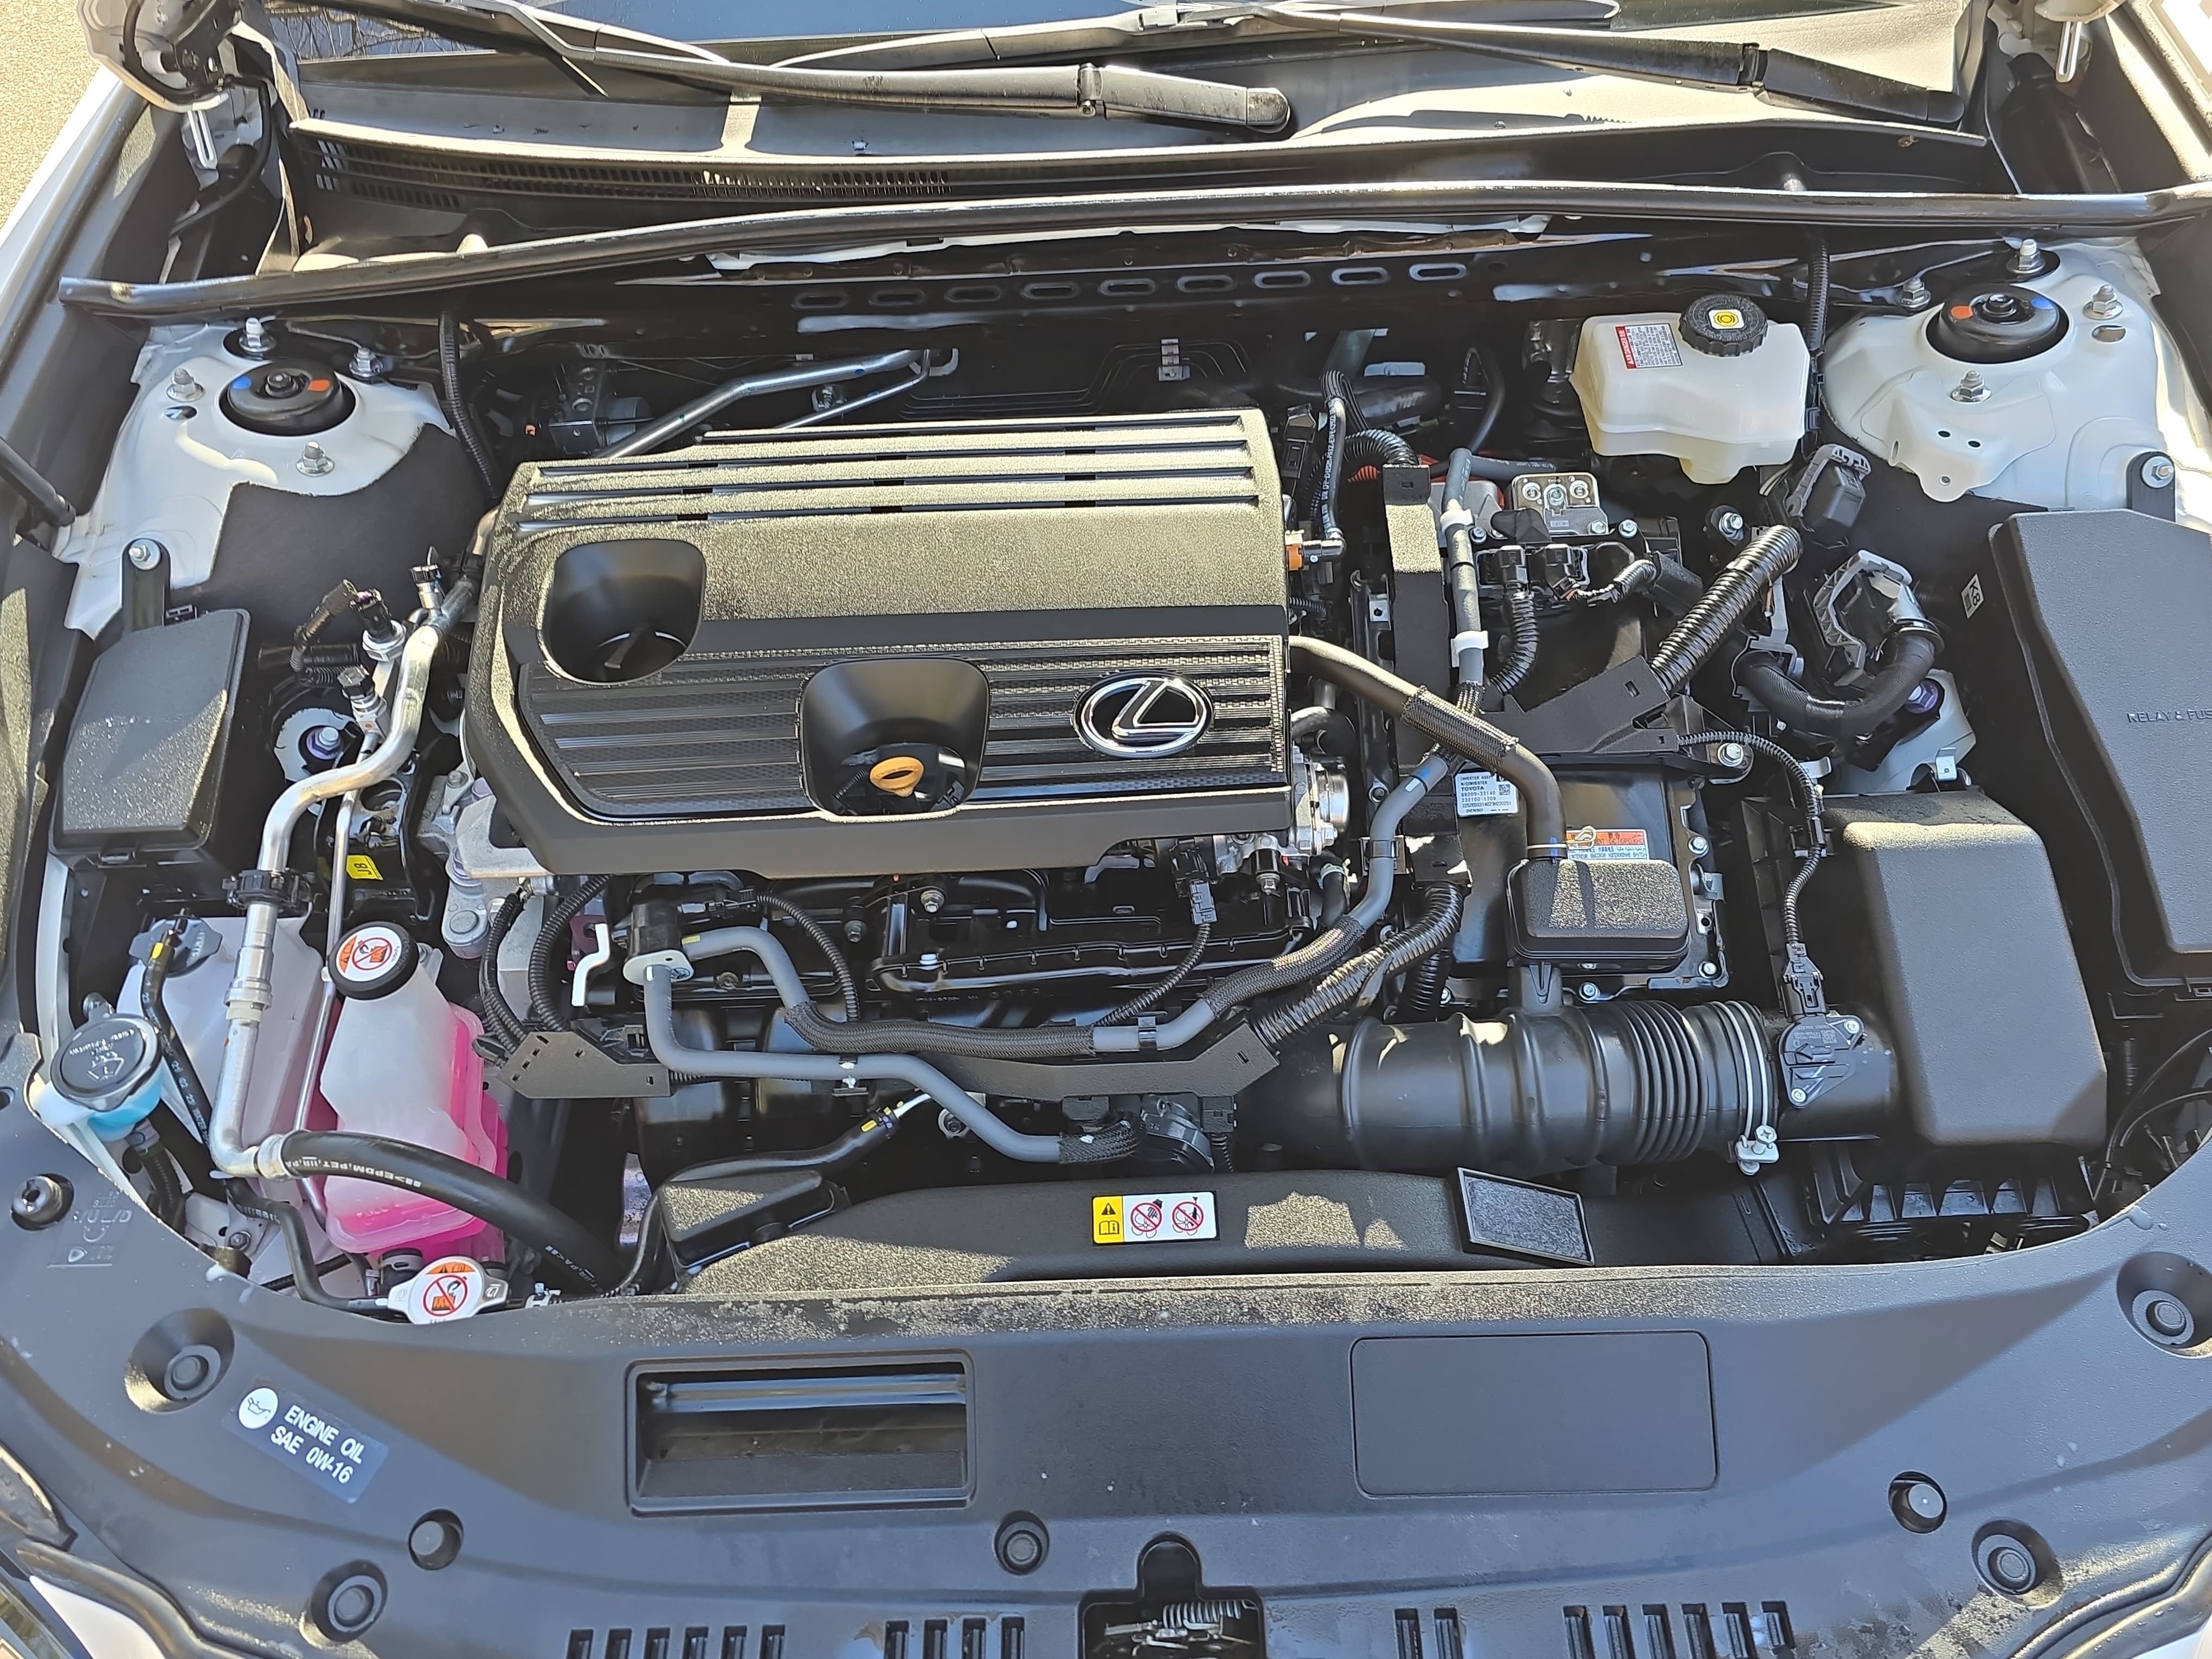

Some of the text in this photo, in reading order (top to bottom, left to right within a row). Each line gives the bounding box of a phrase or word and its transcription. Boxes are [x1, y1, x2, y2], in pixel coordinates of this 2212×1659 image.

[1969, 580, 1980, 606] K8
[2126, 710, 2171, 723] RELAY
[271, 1425, 353, 1484] SAE 0W-16
[284, 1405, 364, 1464] ENGINE OIL
